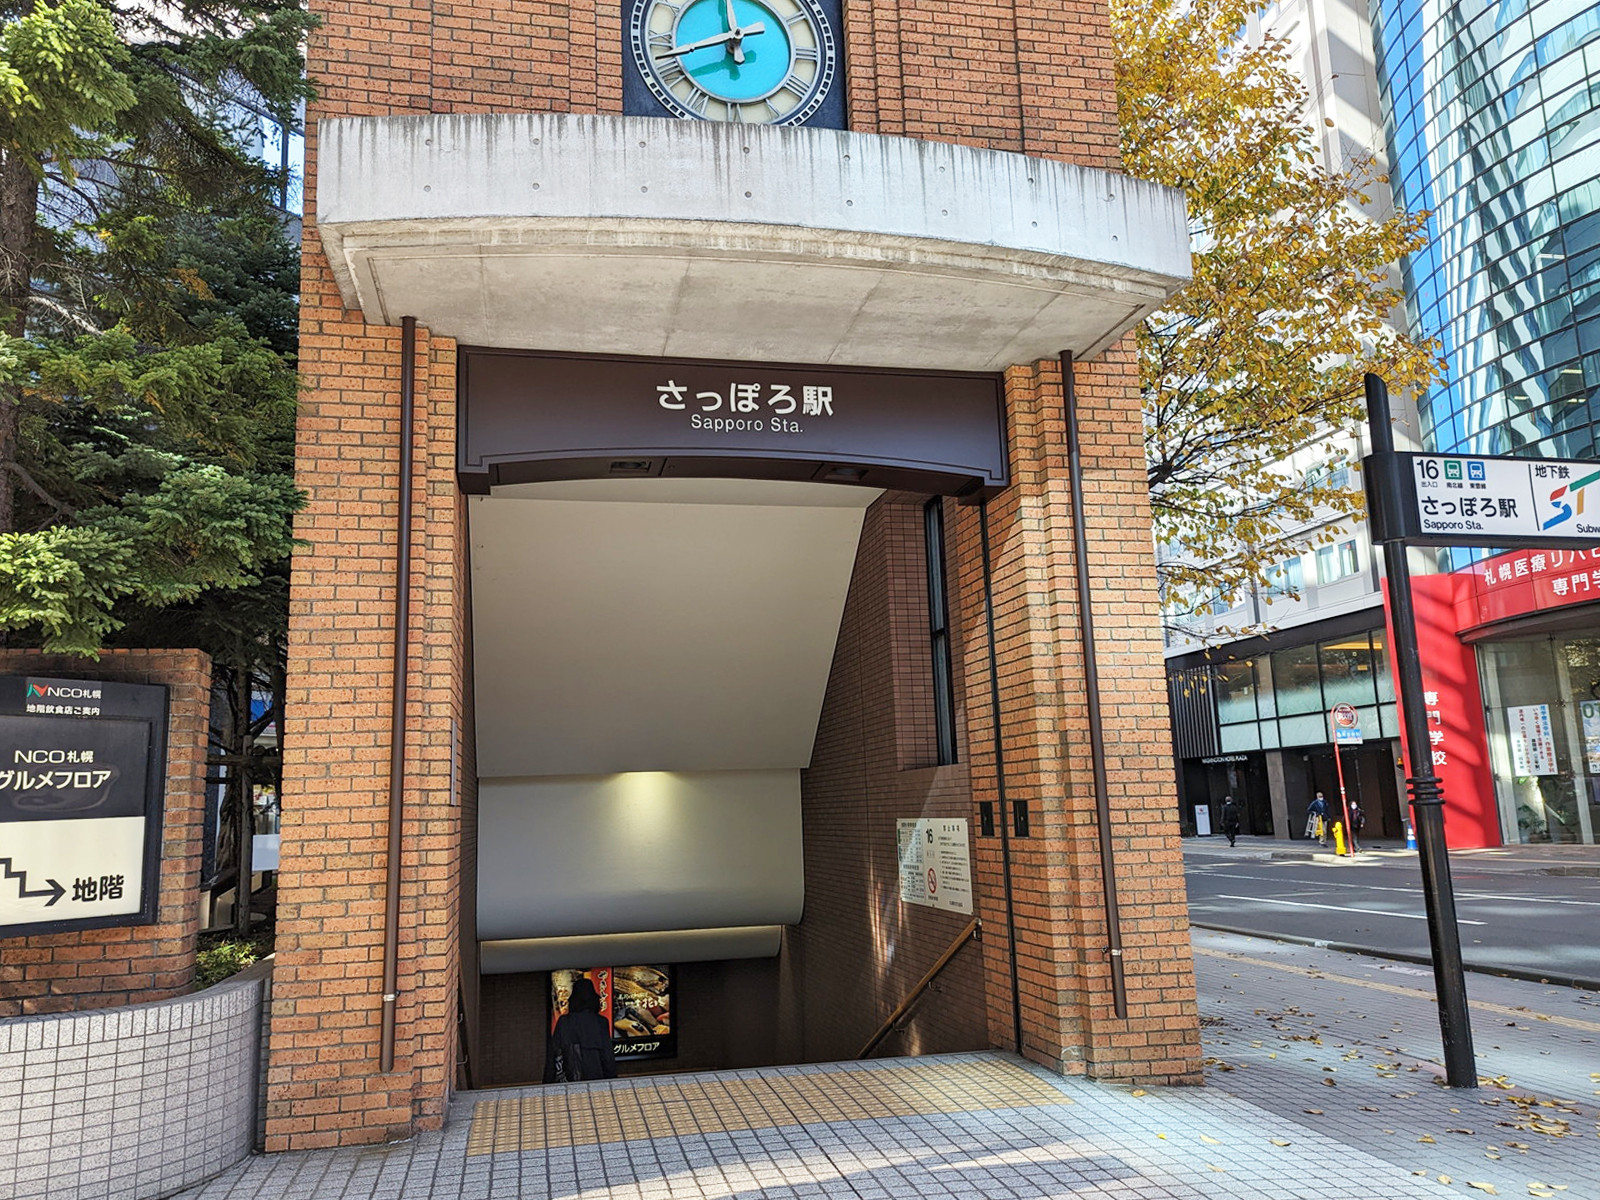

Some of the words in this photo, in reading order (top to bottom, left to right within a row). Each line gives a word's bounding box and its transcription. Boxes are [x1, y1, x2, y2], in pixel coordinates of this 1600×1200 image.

[656, 380, 834, 416] さっぽろ駅
[691, 414, 763, 432] Sapporo
[770, 417, 803, 433] Sta.
[1417, 459, 1439, 479] 16
[1535, 464, 1570, 479] 地下鉄
[1421, 496, 1518, 518] さっぽろ駅
[1423, 519, 1463, 531] Sapporo
[1465, 520, 1484, 530] Sta.
[26, 703, 100, 716] 地階飲食店ご案内
[1424, 691, 1447, 766] 専門学校
[0, 769, 111, 791] グルメフロア
[925, 828, 934, 843] 16
[72, 874, 124, 902] 地階
